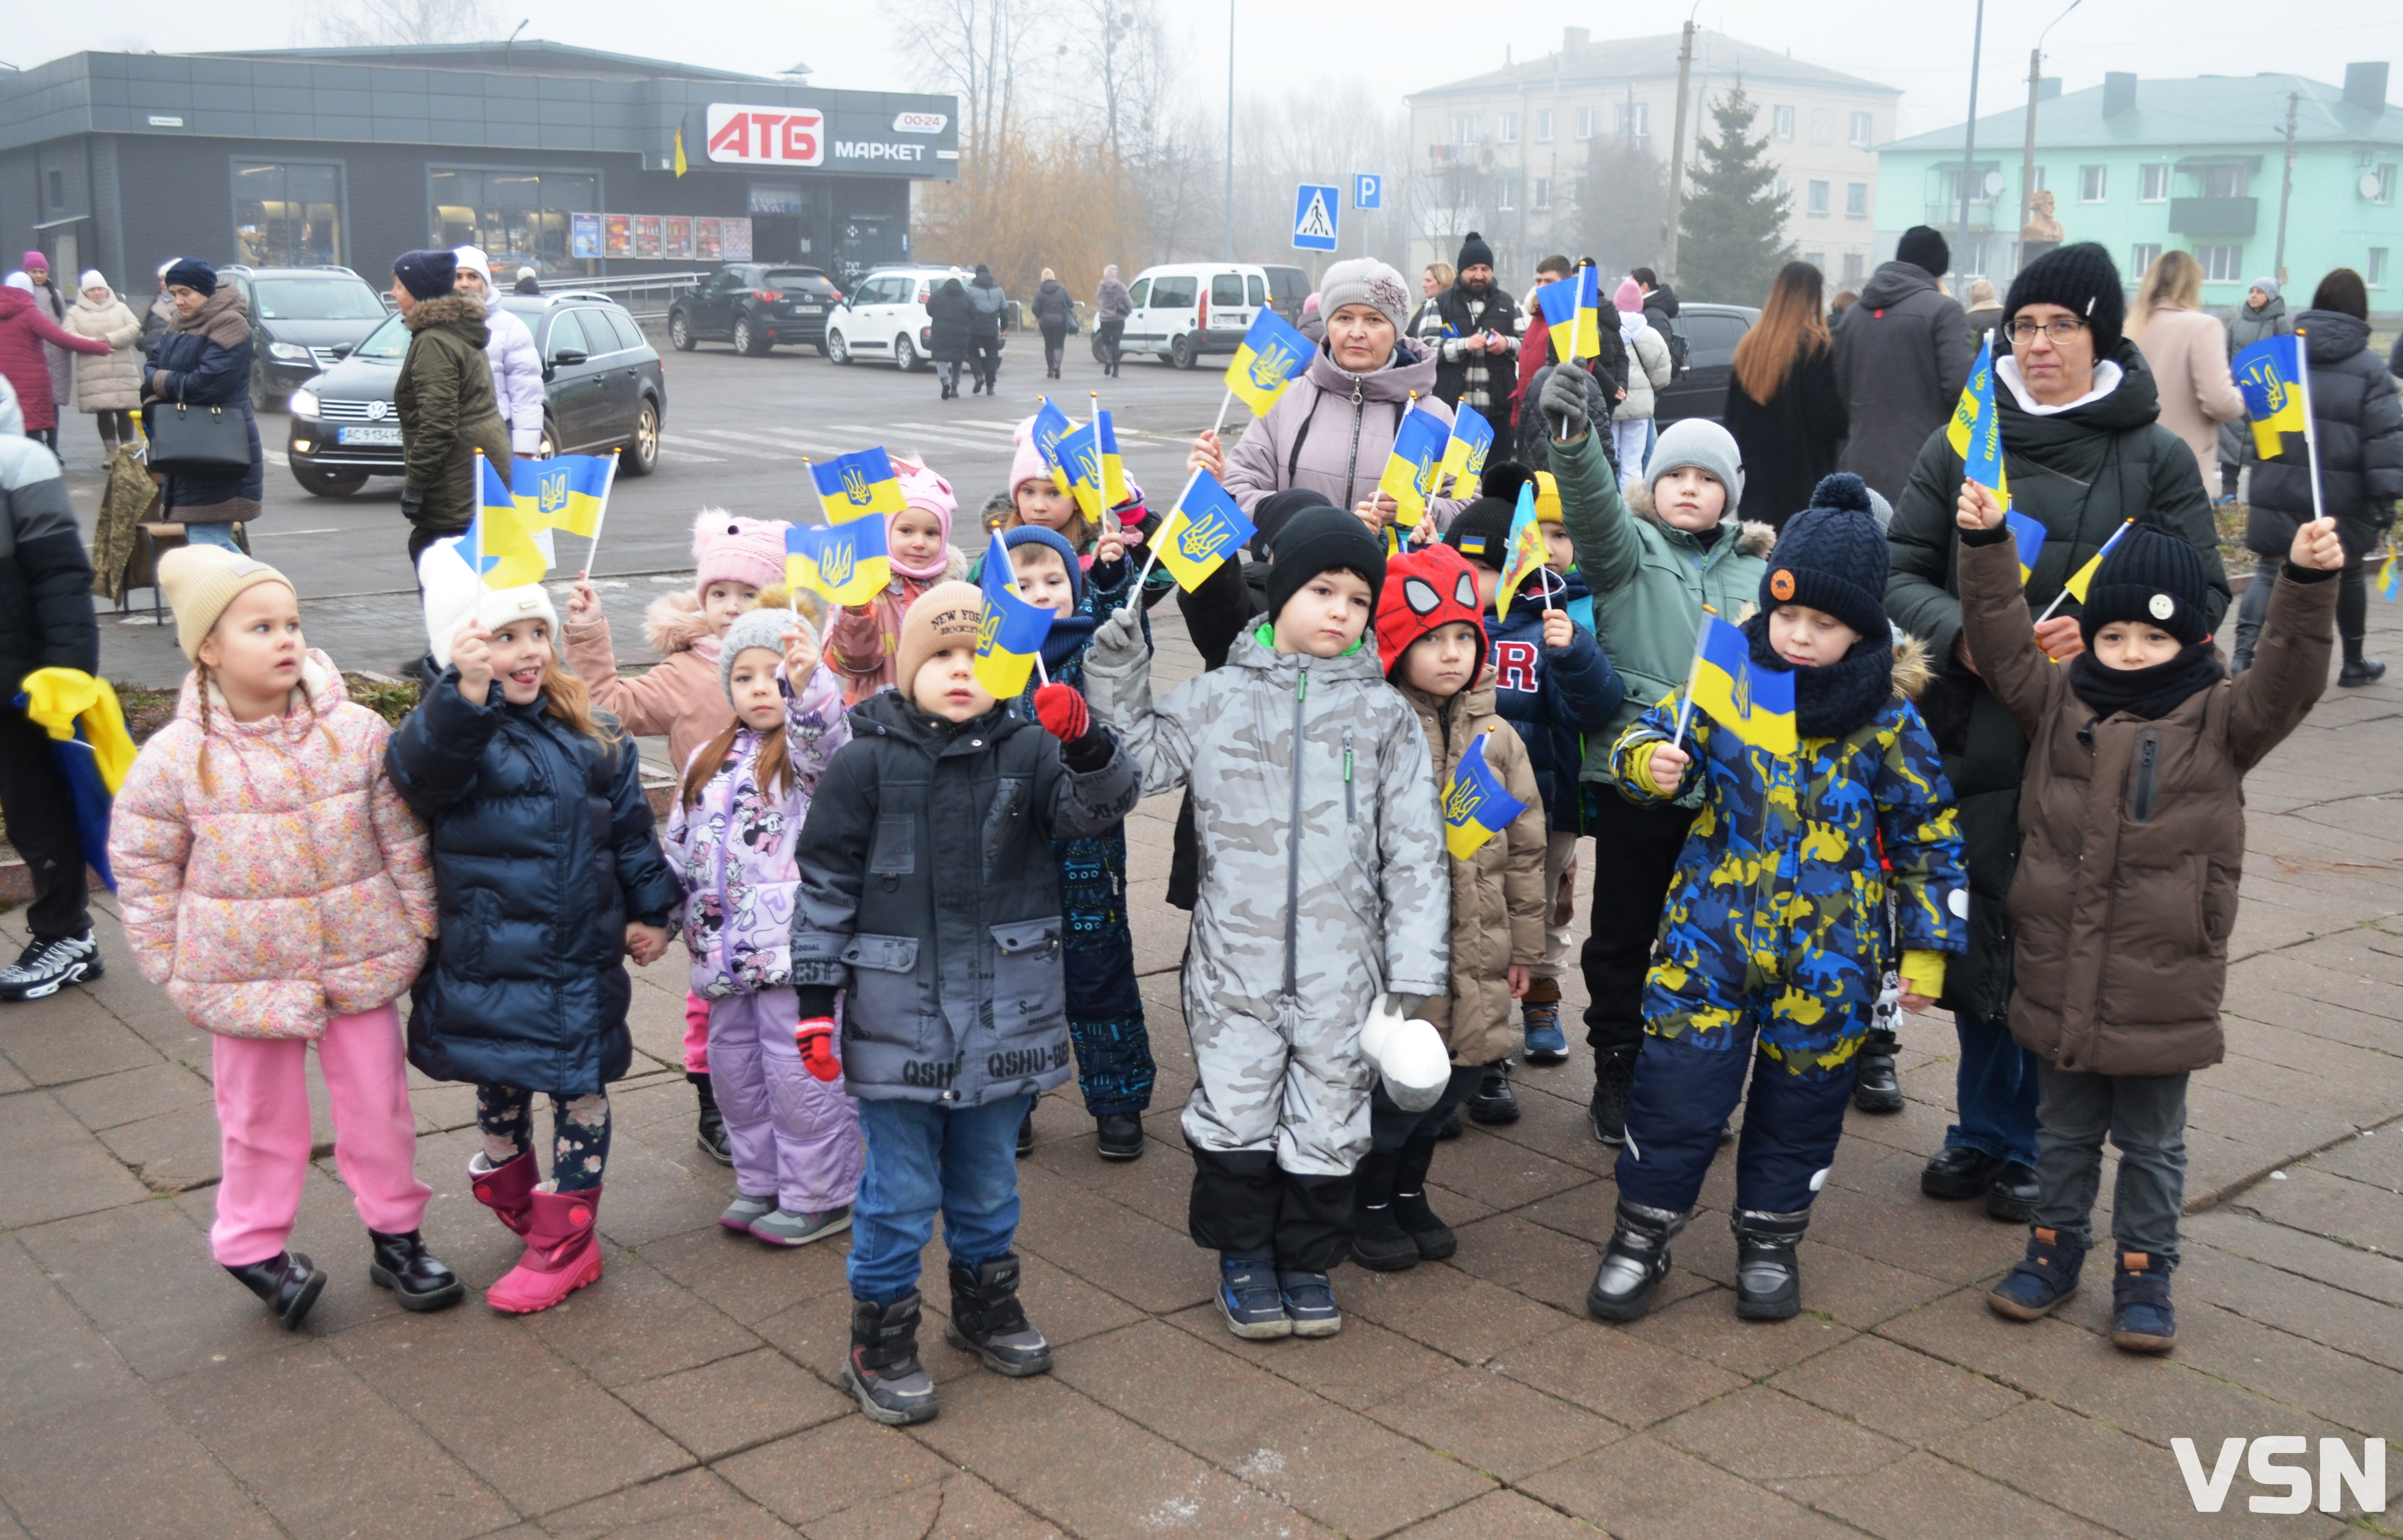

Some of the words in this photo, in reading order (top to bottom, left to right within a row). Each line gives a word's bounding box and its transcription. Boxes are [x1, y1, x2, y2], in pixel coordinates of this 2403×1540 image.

[710, 112, 821, 160] АТБ
[835, 141, 925, 161] МАРКЕТ
[1362, 178, 1375, 205] P
[931, 609, 956, 630] NEW
[961, 609, 981, 624] YOR
[1495, 641, 1539, 693] R
